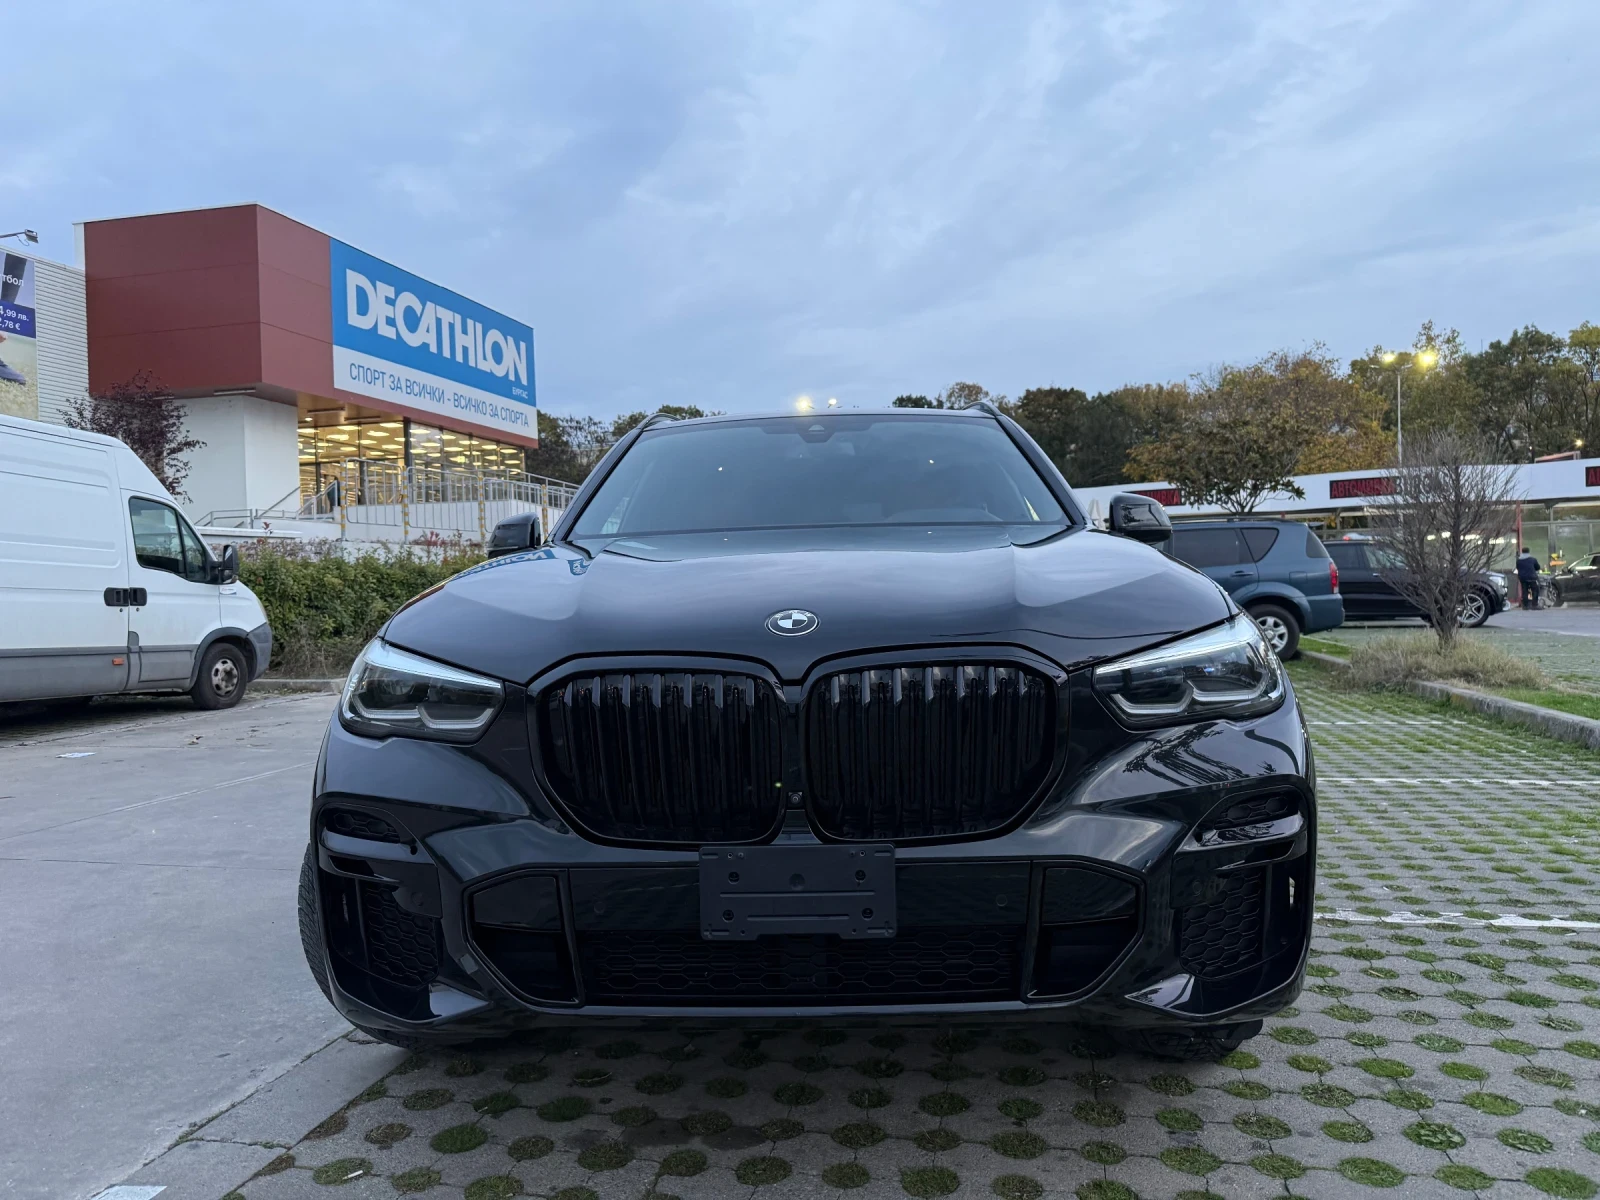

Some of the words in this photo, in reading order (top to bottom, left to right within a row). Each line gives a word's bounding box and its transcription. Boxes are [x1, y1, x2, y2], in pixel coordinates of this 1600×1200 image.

[346, 268, 527, 386] DECATHLON
[349, 363, 386, 388] СПОРТ
[389, 374, 403, 393] ЗА
[405, 378, 445, 404] ВСИЧКИ
[453, 392, 487, 416] ВСИЧКО
[489, 403, 499, 419] ЗА
[500, 406, 529, 427] СПОРТА
[1332, 478, 1395, 498] АВТОМИВКА
